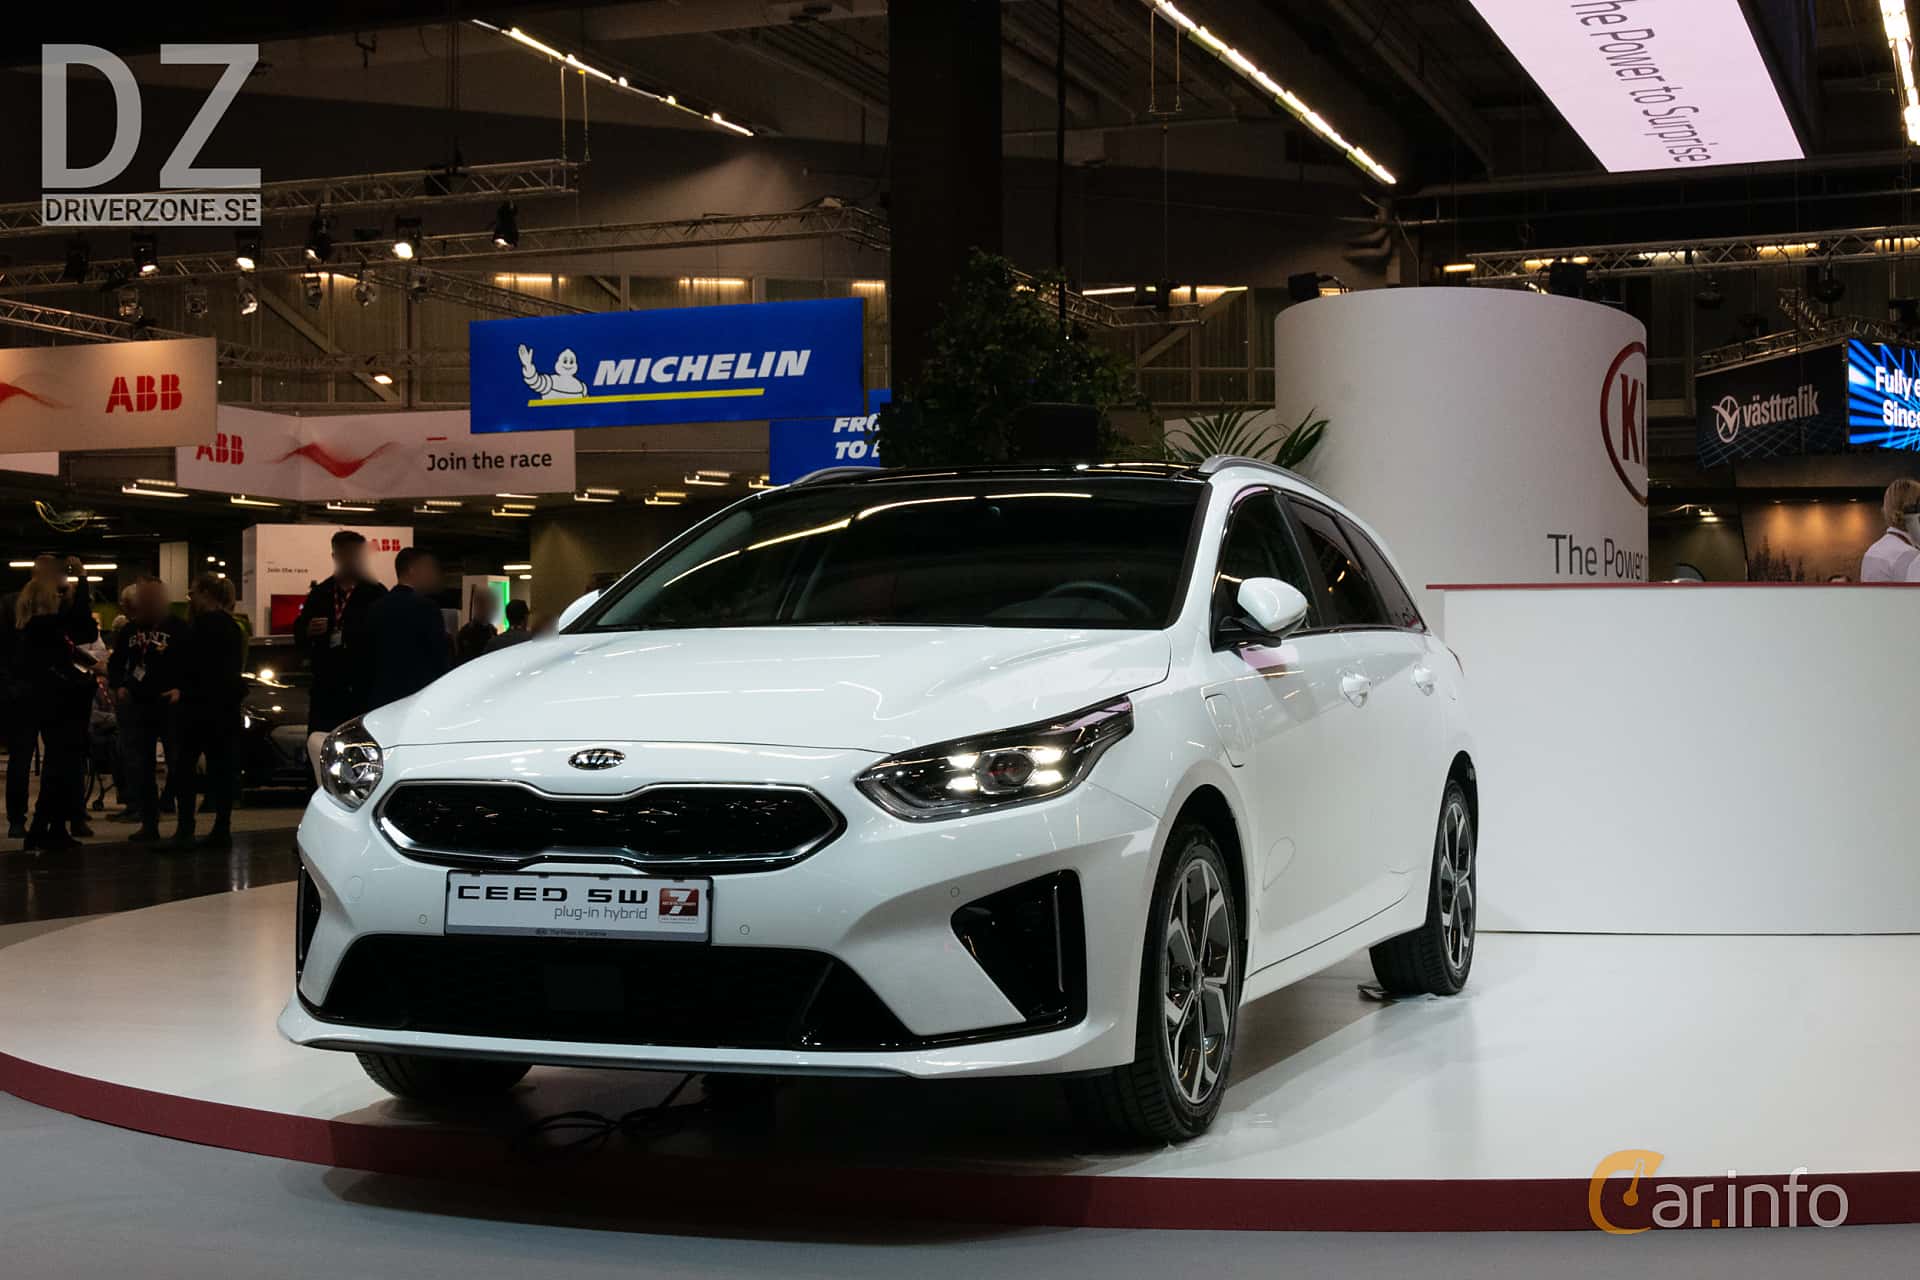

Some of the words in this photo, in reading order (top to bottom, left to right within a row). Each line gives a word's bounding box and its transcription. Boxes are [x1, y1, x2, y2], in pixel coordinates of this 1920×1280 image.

[1570, 0, 1637, 26] he
[1590, 28, 1665, 82] Power
[1629, 86, 1683, 104] to
[1642, 106, 1719, 163] Surprise
[593, 350, 811, 386] MICHELIN
[1875, 366, 1912, 400] Fully
[105, 374, 183, 413] ABB
[1743, 384, 1820, 428] västtrafik
[833, 413, 880, 434] FRO
[427, 454, 466, 471] Join
[472, 451, 504, 469] the
[510, 453, 552, 468] race
[835, 440, 868, 460] TO
[1547, 534, 1598, 576] The
[1604, 538, 1644, 580] Power
[458, 885, 568, 902] CEED
[587, 889, 649, 904] SW
[554, 904, 600, 920] plug-in
[604, 907, 648, 922] hybrid
